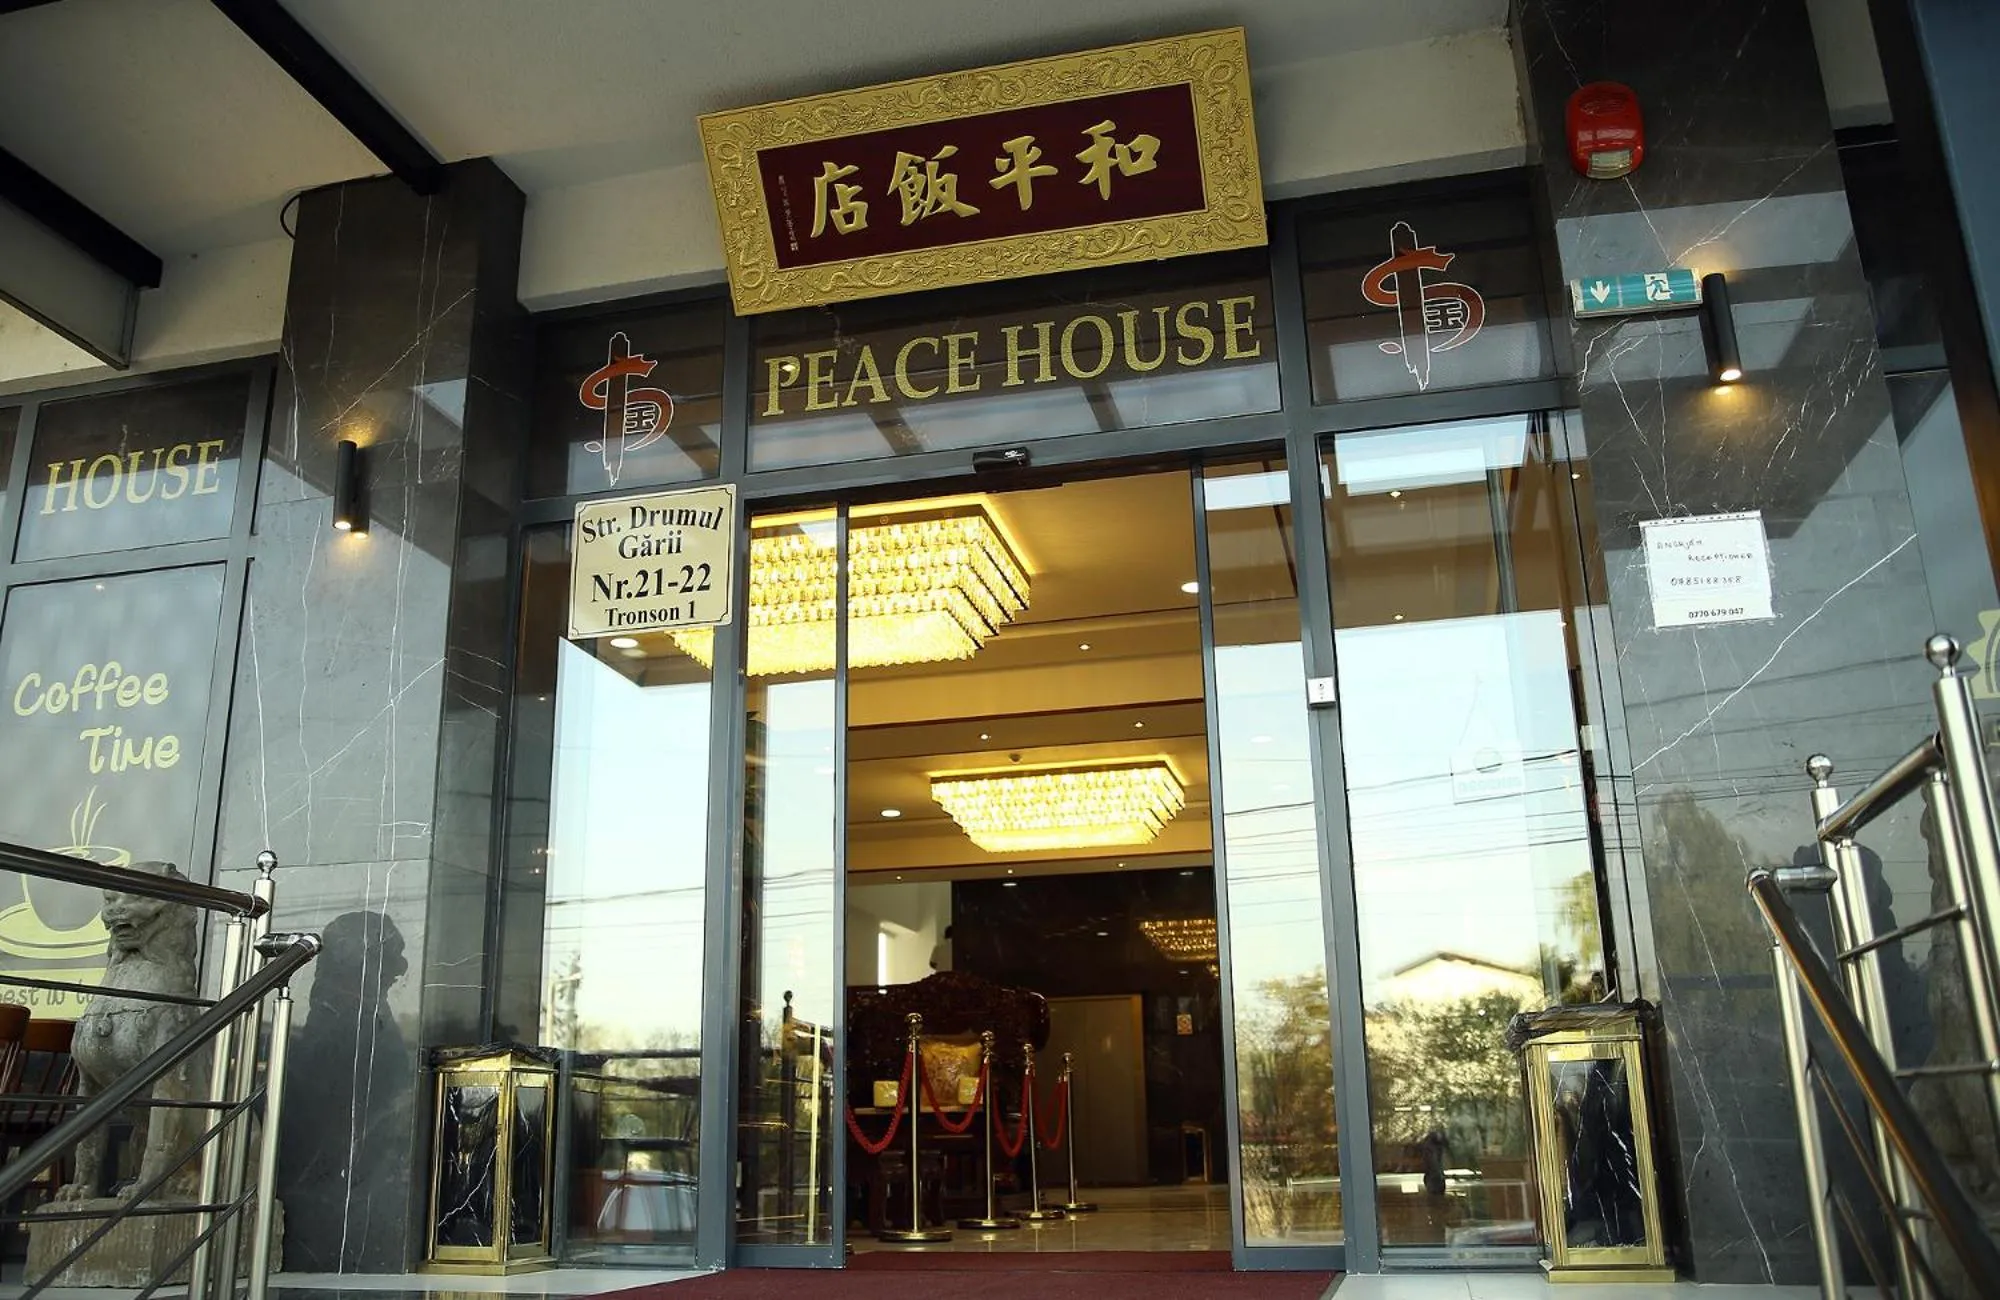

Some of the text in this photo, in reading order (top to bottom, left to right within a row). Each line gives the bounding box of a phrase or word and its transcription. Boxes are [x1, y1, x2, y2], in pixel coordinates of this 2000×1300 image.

[762, 296, 1262, 417] PEACE HOUSE
[40, 439, 224, 515] HOUSE
[582, 505, 724, 543] Str. Drumul
[618, 530, 682, 560] Gării
[591, 563, 712, 603] Nr.21-22
[605, 601, 695, 627] Tronson 1
[14, 661, 169, 717] Coffee
[80, 725, 180, 775] Time
[0, 985, 38, 1006] est
